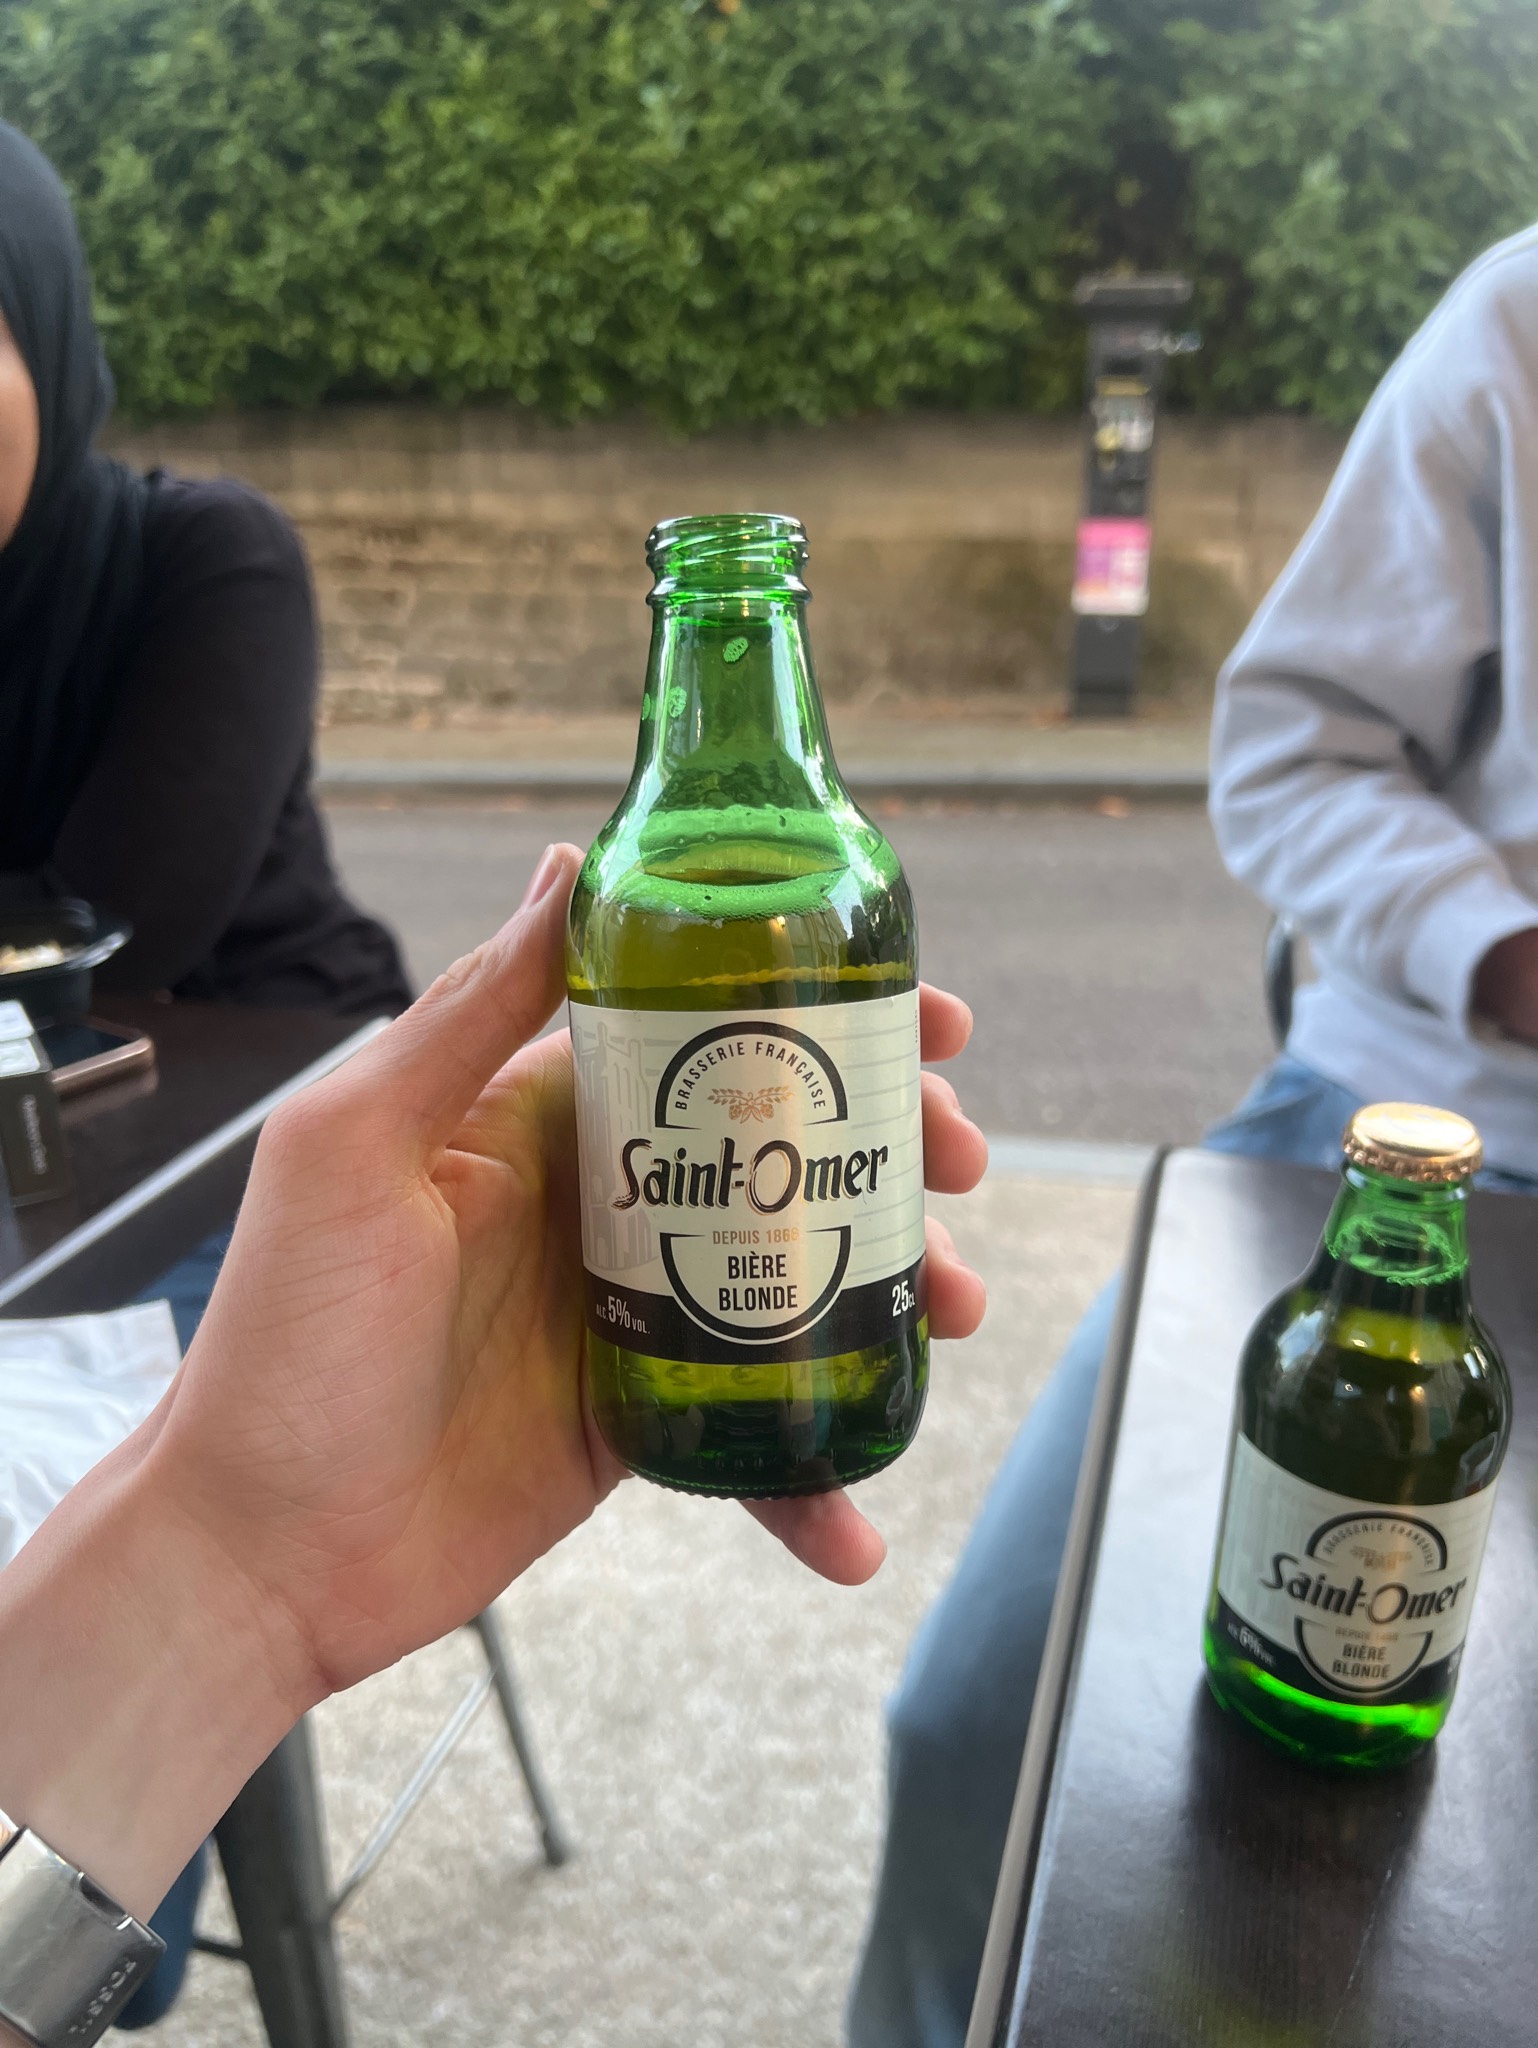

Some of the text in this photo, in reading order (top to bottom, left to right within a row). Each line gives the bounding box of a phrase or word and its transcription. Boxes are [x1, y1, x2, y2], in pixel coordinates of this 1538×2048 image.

[675, 1041, 826, 1110] BRASSERIE FRANÇAISE
[610, 1137, 889, 1215] Saint-Omer
[712, 1227, 800, 1245] DEPUIS 1866
[727, 1250, 787, 1280] BIÈRE
[608, 1295, 631, 1329] 5%
[718, 1284, 798, 1312] BLONDE
[1258, 1552, 1468, 1625] Saint-Omer
[1342, 1643, 1388, 1661] BIÈRE
[1332, 1658, 1391, 1679] BLONDE
[67, 1957, 137, 2036] FOSS
